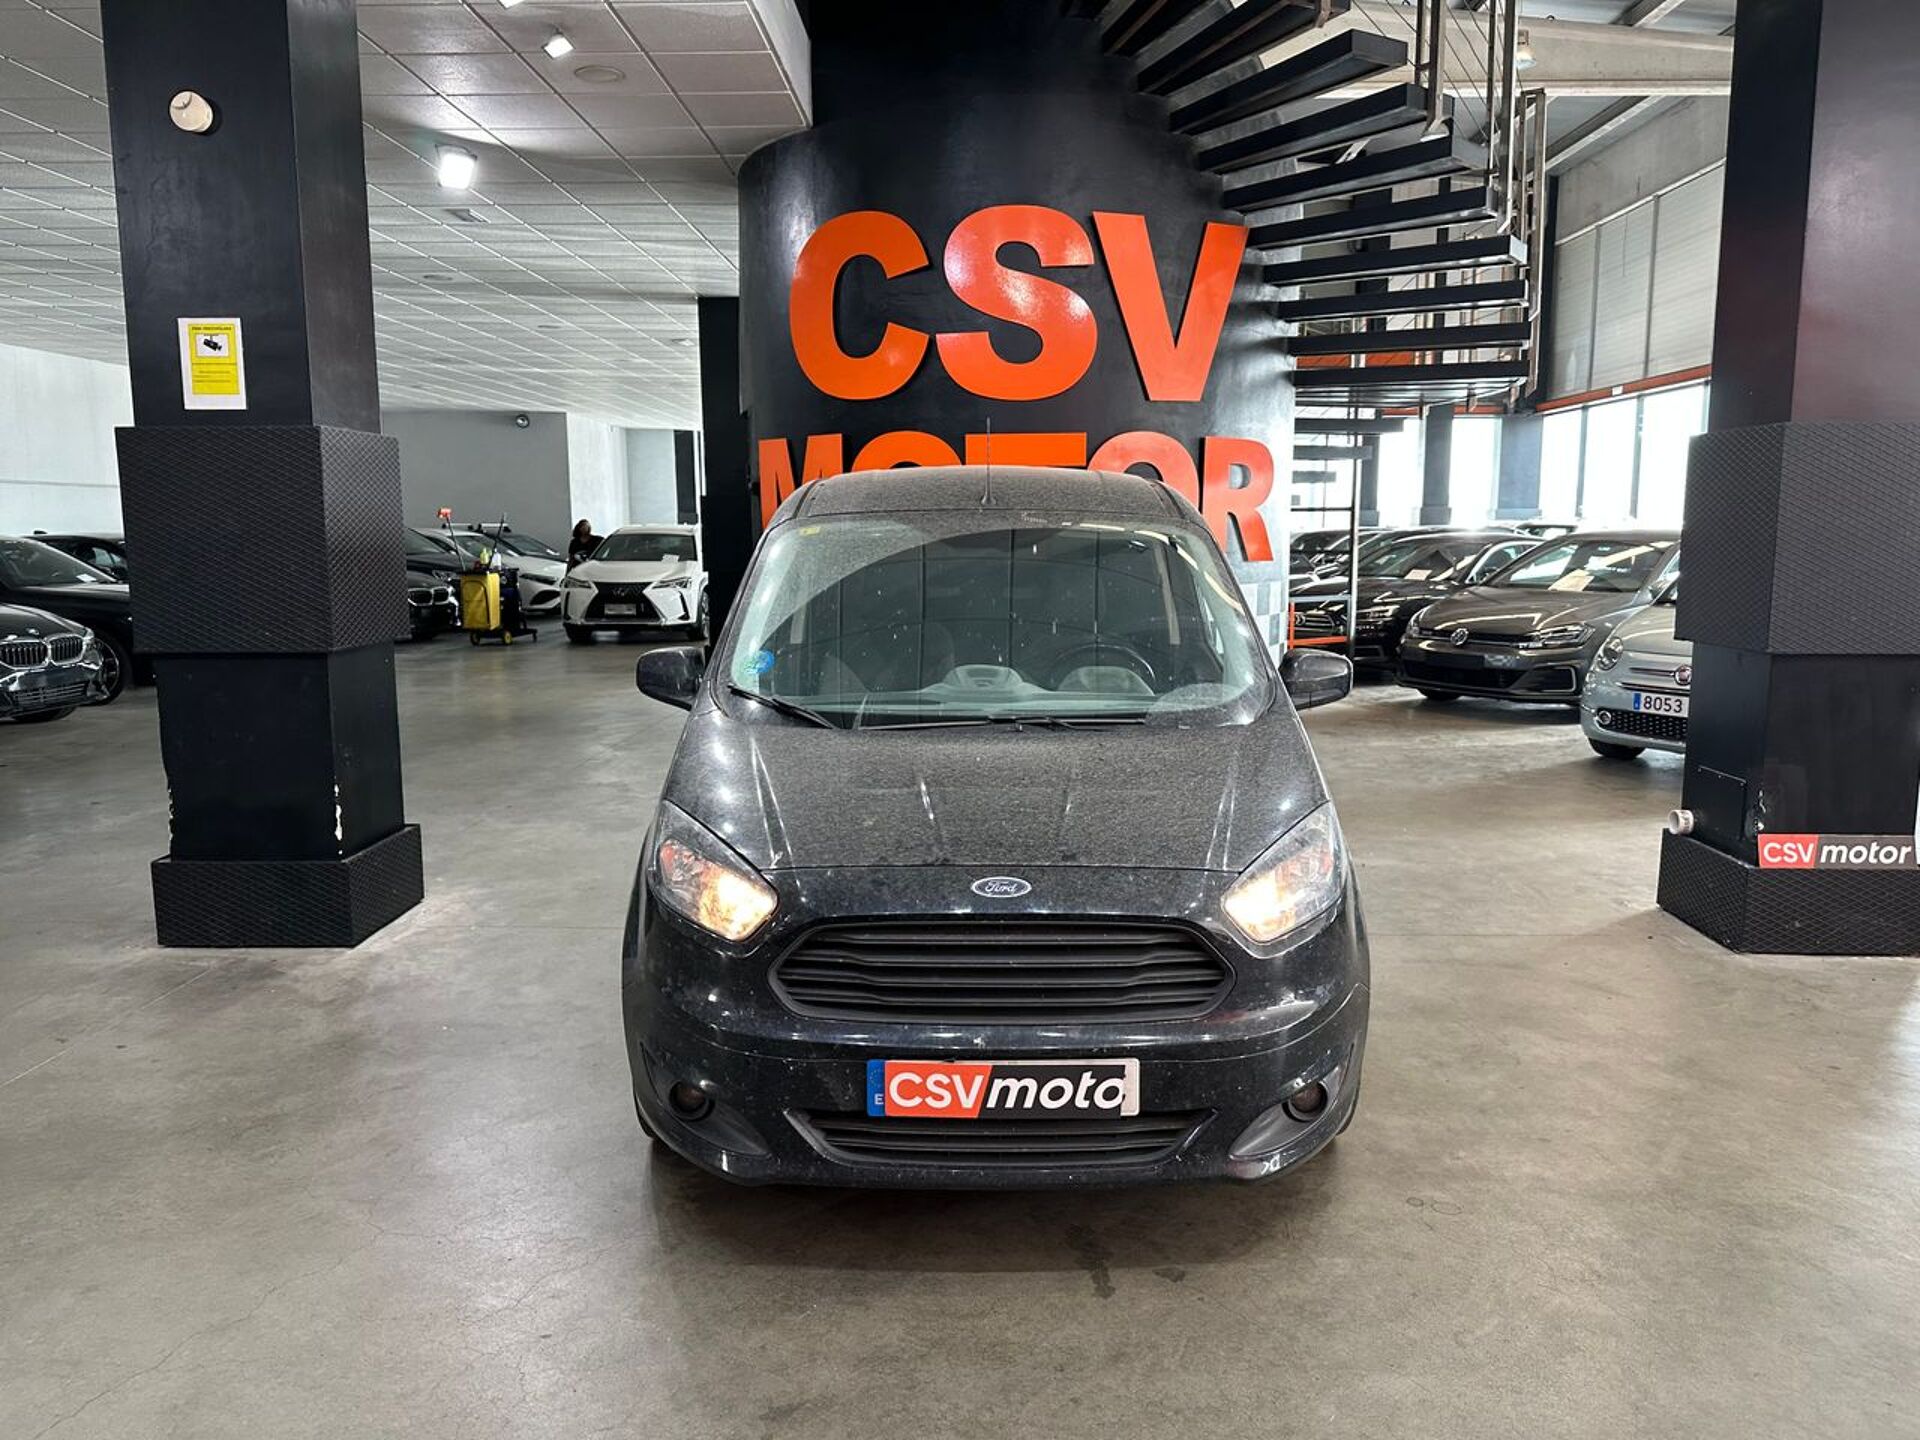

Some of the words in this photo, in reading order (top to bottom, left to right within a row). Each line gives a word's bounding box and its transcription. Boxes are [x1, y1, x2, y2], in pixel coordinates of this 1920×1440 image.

[788, 204, 1248, 402] CSV
[1643, 696, 1682, 713] 8053
[985, 880, 1018, 892] Ford
